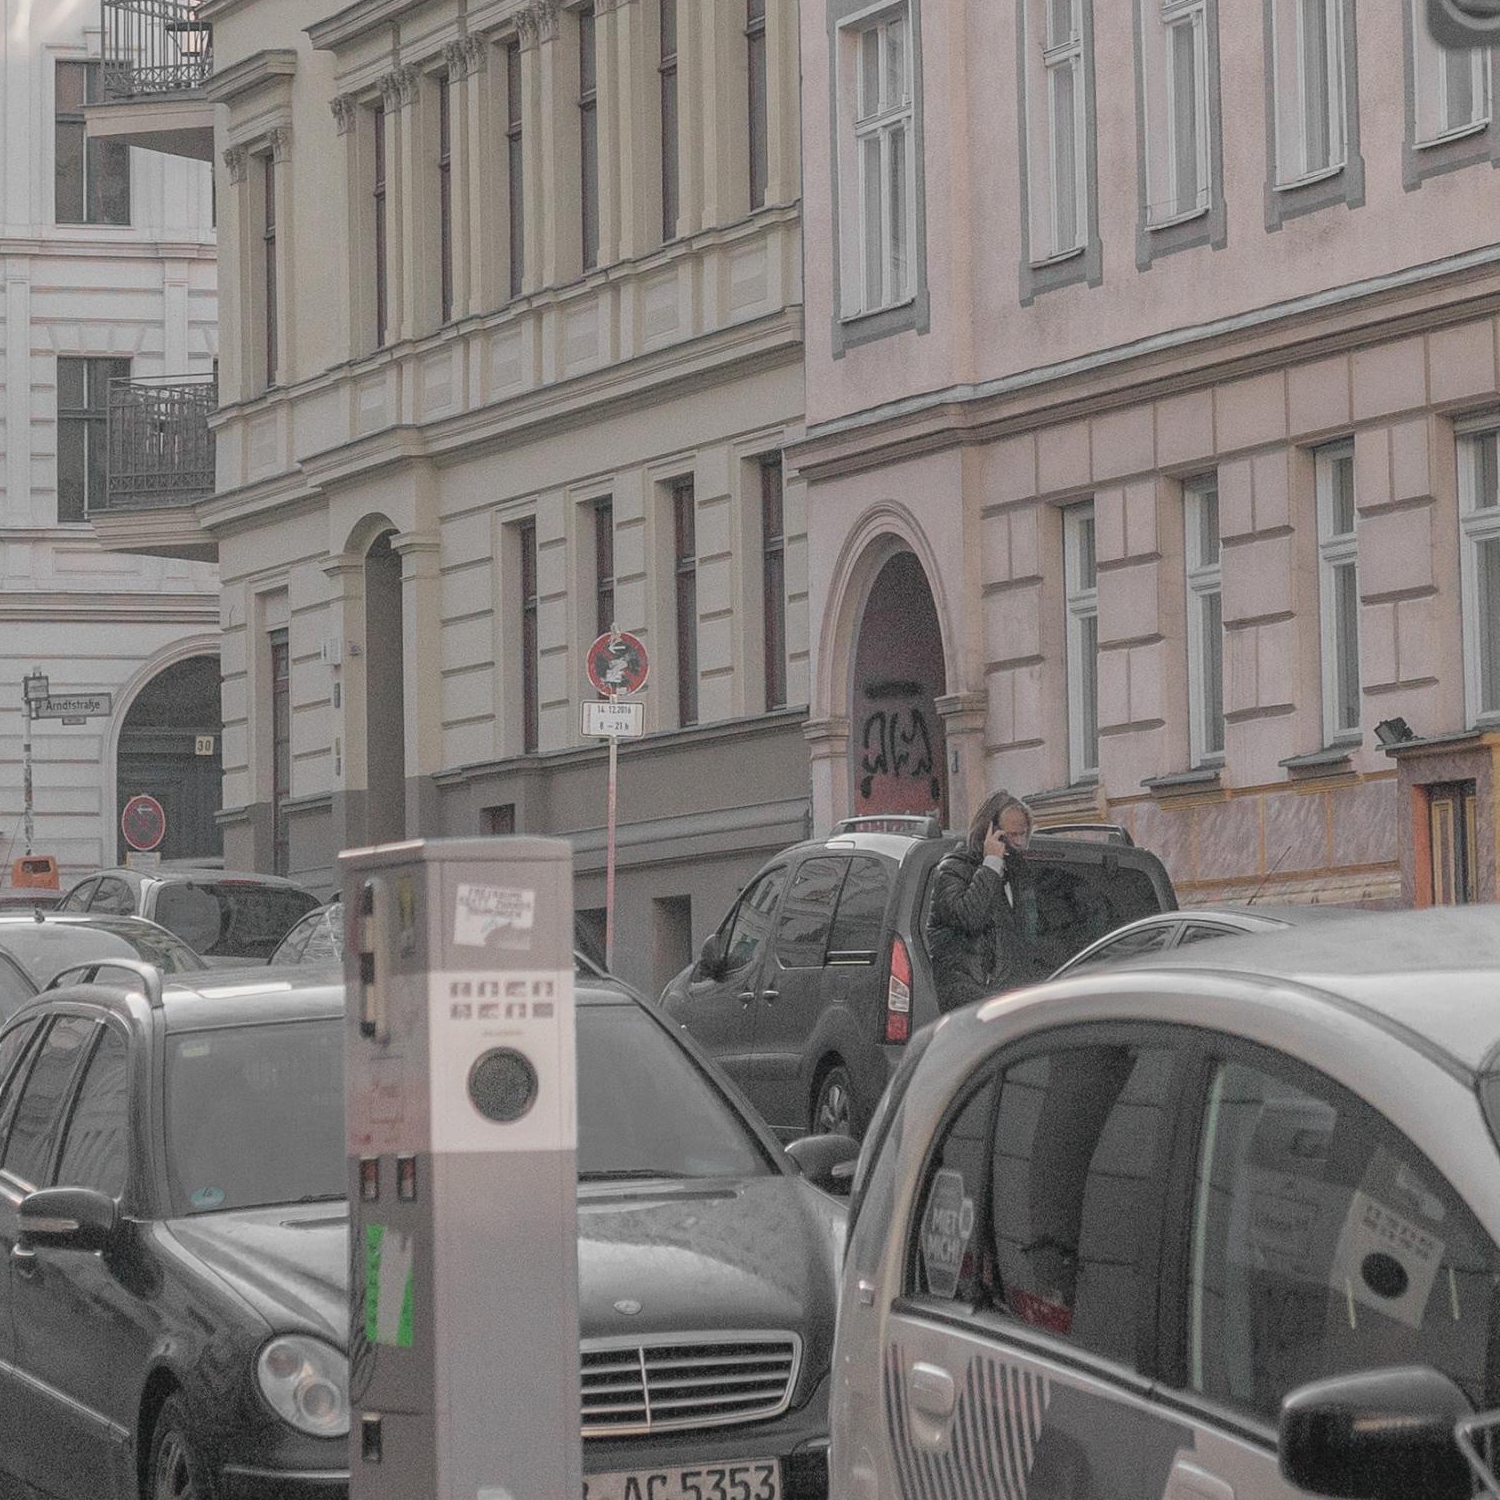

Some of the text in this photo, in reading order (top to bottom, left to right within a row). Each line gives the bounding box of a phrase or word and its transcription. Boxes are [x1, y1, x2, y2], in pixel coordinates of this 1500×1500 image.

[46, 699, 101, 713] Arndtstraße
[196, 740, 211, 751] 30
[681, 1465, 775, 1500] 5353
